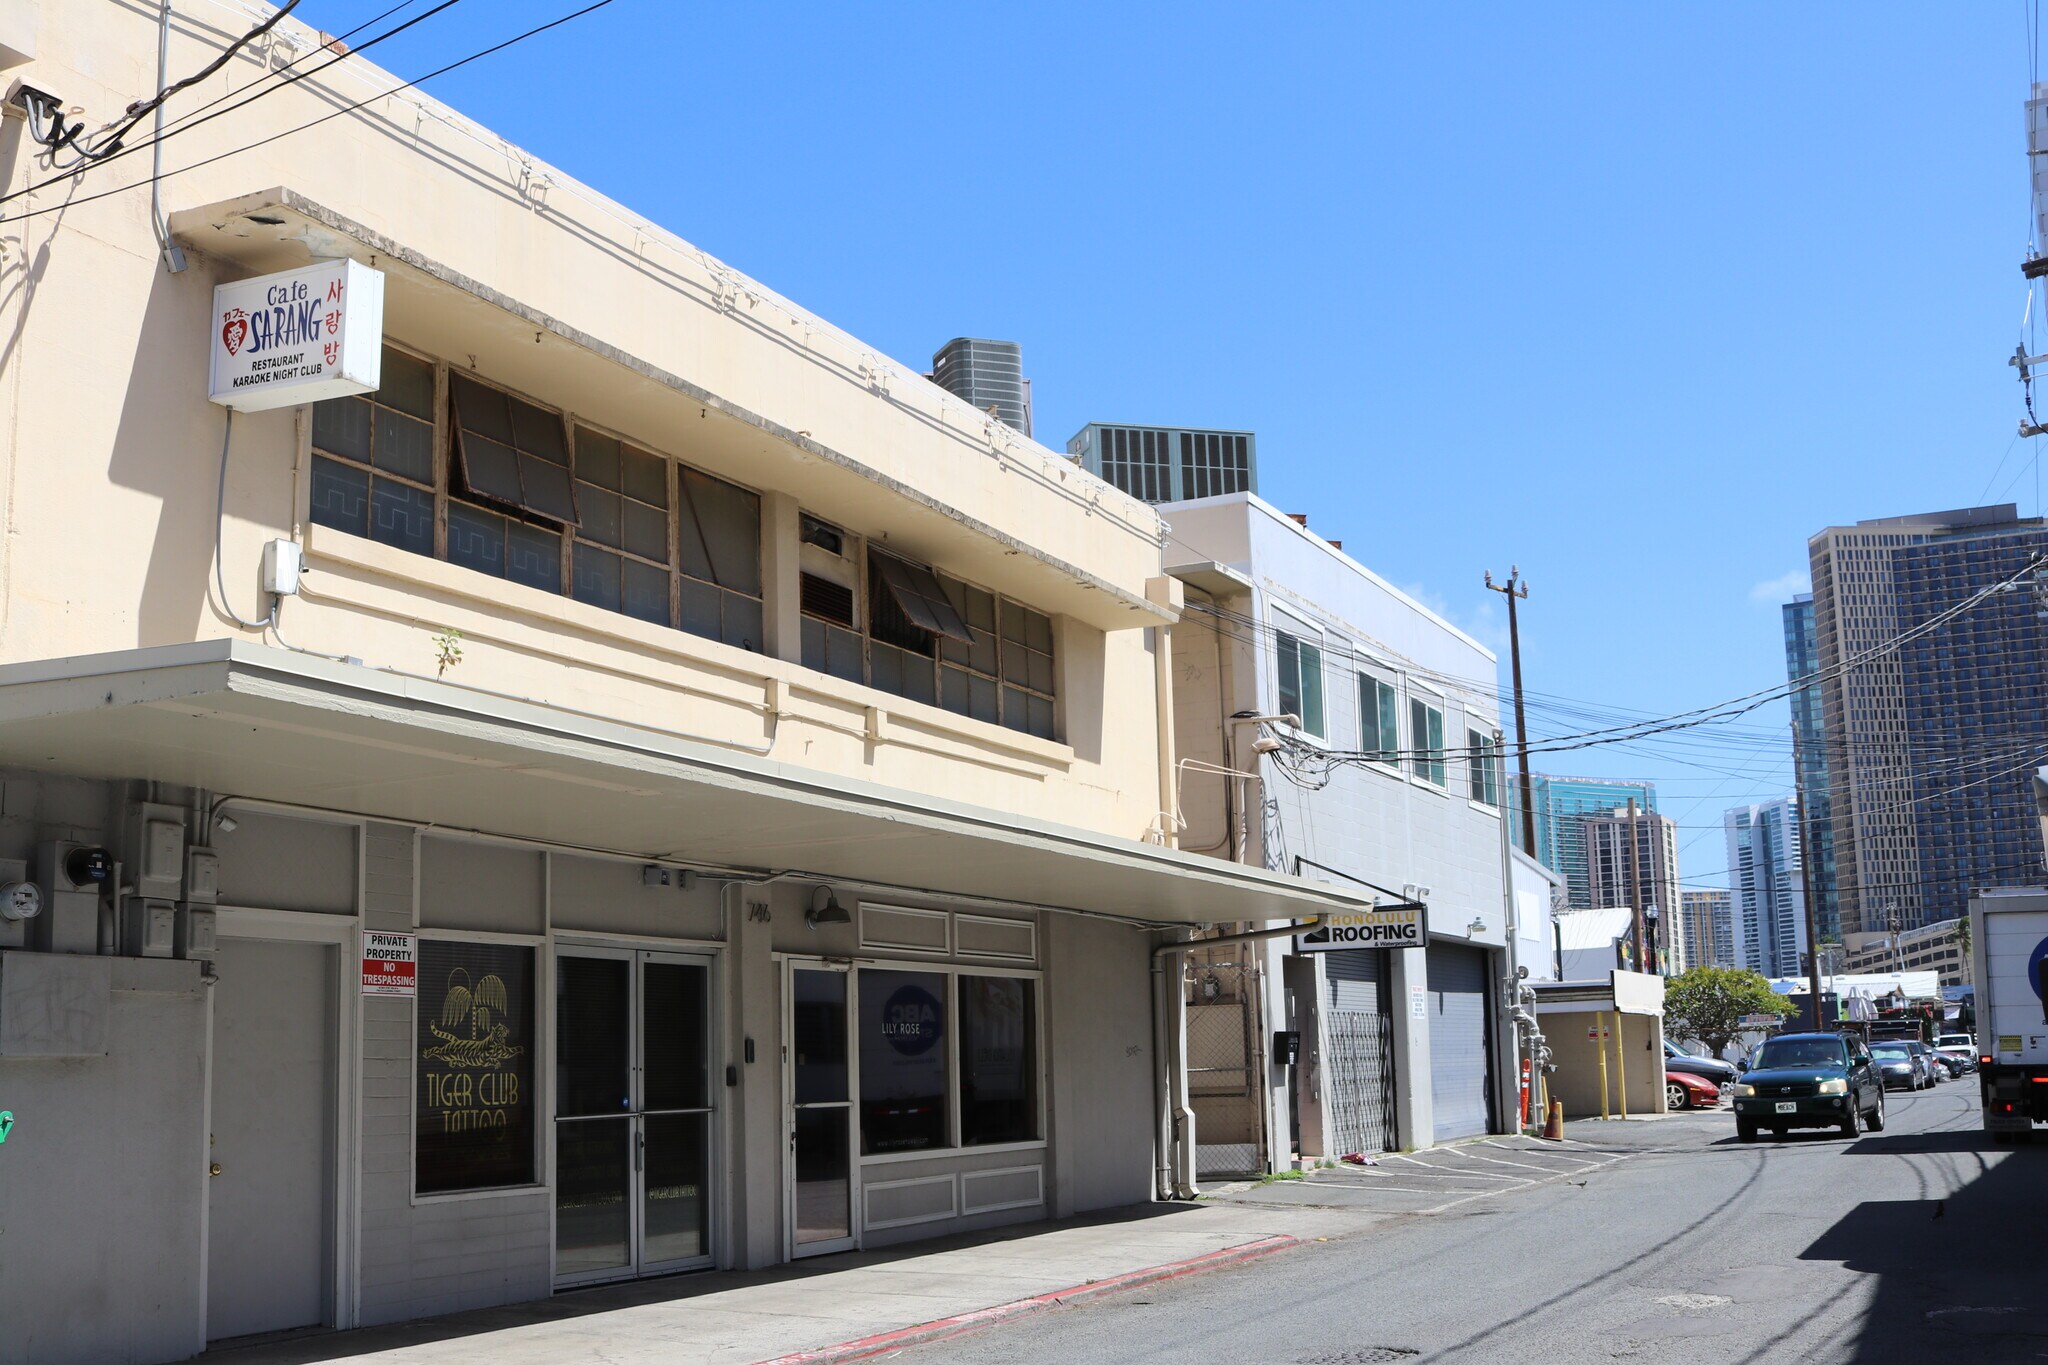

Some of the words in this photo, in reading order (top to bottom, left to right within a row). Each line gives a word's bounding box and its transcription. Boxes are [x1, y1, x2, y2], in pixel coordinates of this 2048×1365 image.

[267, 281, 307, 306] Cafe
[223, 308, 250, 322] カフェー
[324, 278, 344, 366] 사랑방
[246, 298, 323, 353] SARANG
[227, 323, 243, 353] 愛
[252, 353, 304, 371] RESTAURANT
[233, 371, 270, 388] KARAOKE
[273, 368, 298, 381] NIGHT
[301, 363, 322, 377] CLUB
[1331, 912, 1416, 926] HONOLULU
[371, 935, 408, 947] PRIVATE
[1332, 924, 1416, 942] ROOFING
[366, 948, 412, 961] PROPERTY
[383, 962, 396, 972] NO
[363, 974, 415, 986] TRESPASSING
[881, 1023, 897, 1034] LILY
[900, 1023, 920, 1034] ROSE
[427, 1073, 472, 1107] TIGER
[479, 1072, 519, 1106] CLUB
[442, 1108, 507, 1140] TATTOO
